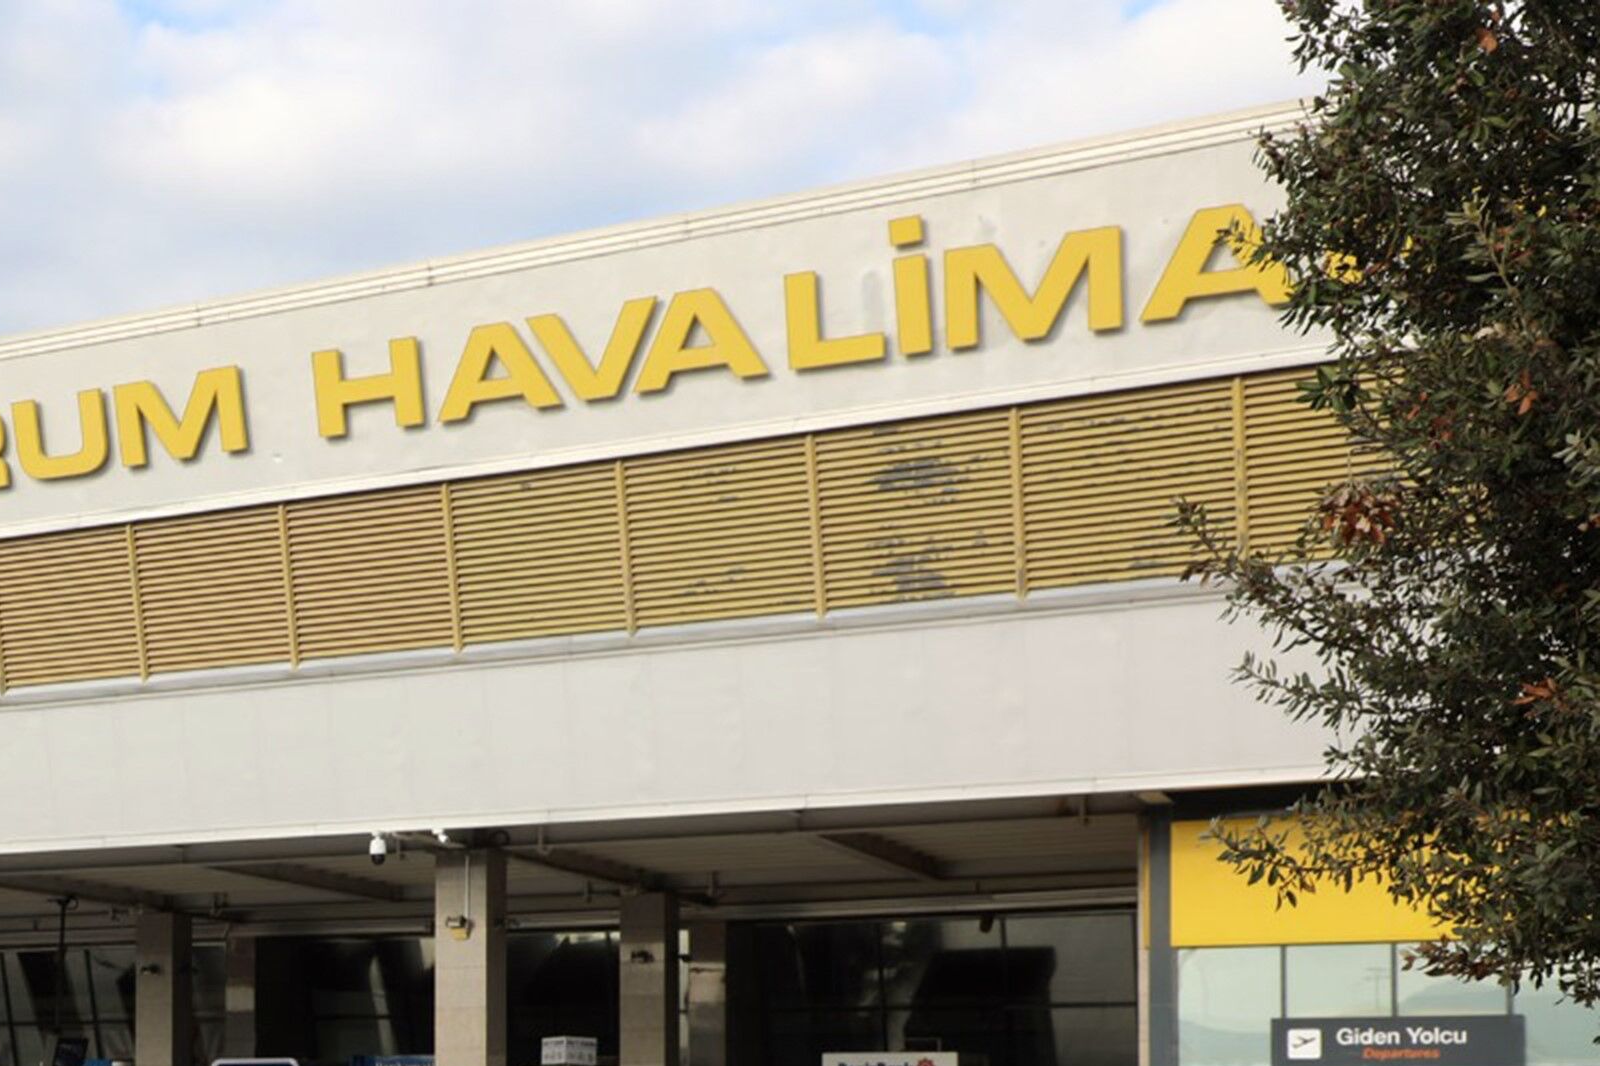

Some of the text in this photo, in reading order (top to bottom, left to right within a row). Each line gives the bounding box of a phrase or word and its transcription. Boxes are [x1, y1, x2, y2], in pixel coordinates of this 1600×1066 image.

[312, 203, 1362, 438] HAVALİMA
[1336, 1026, 1468, 1046] Giden Yolcu
